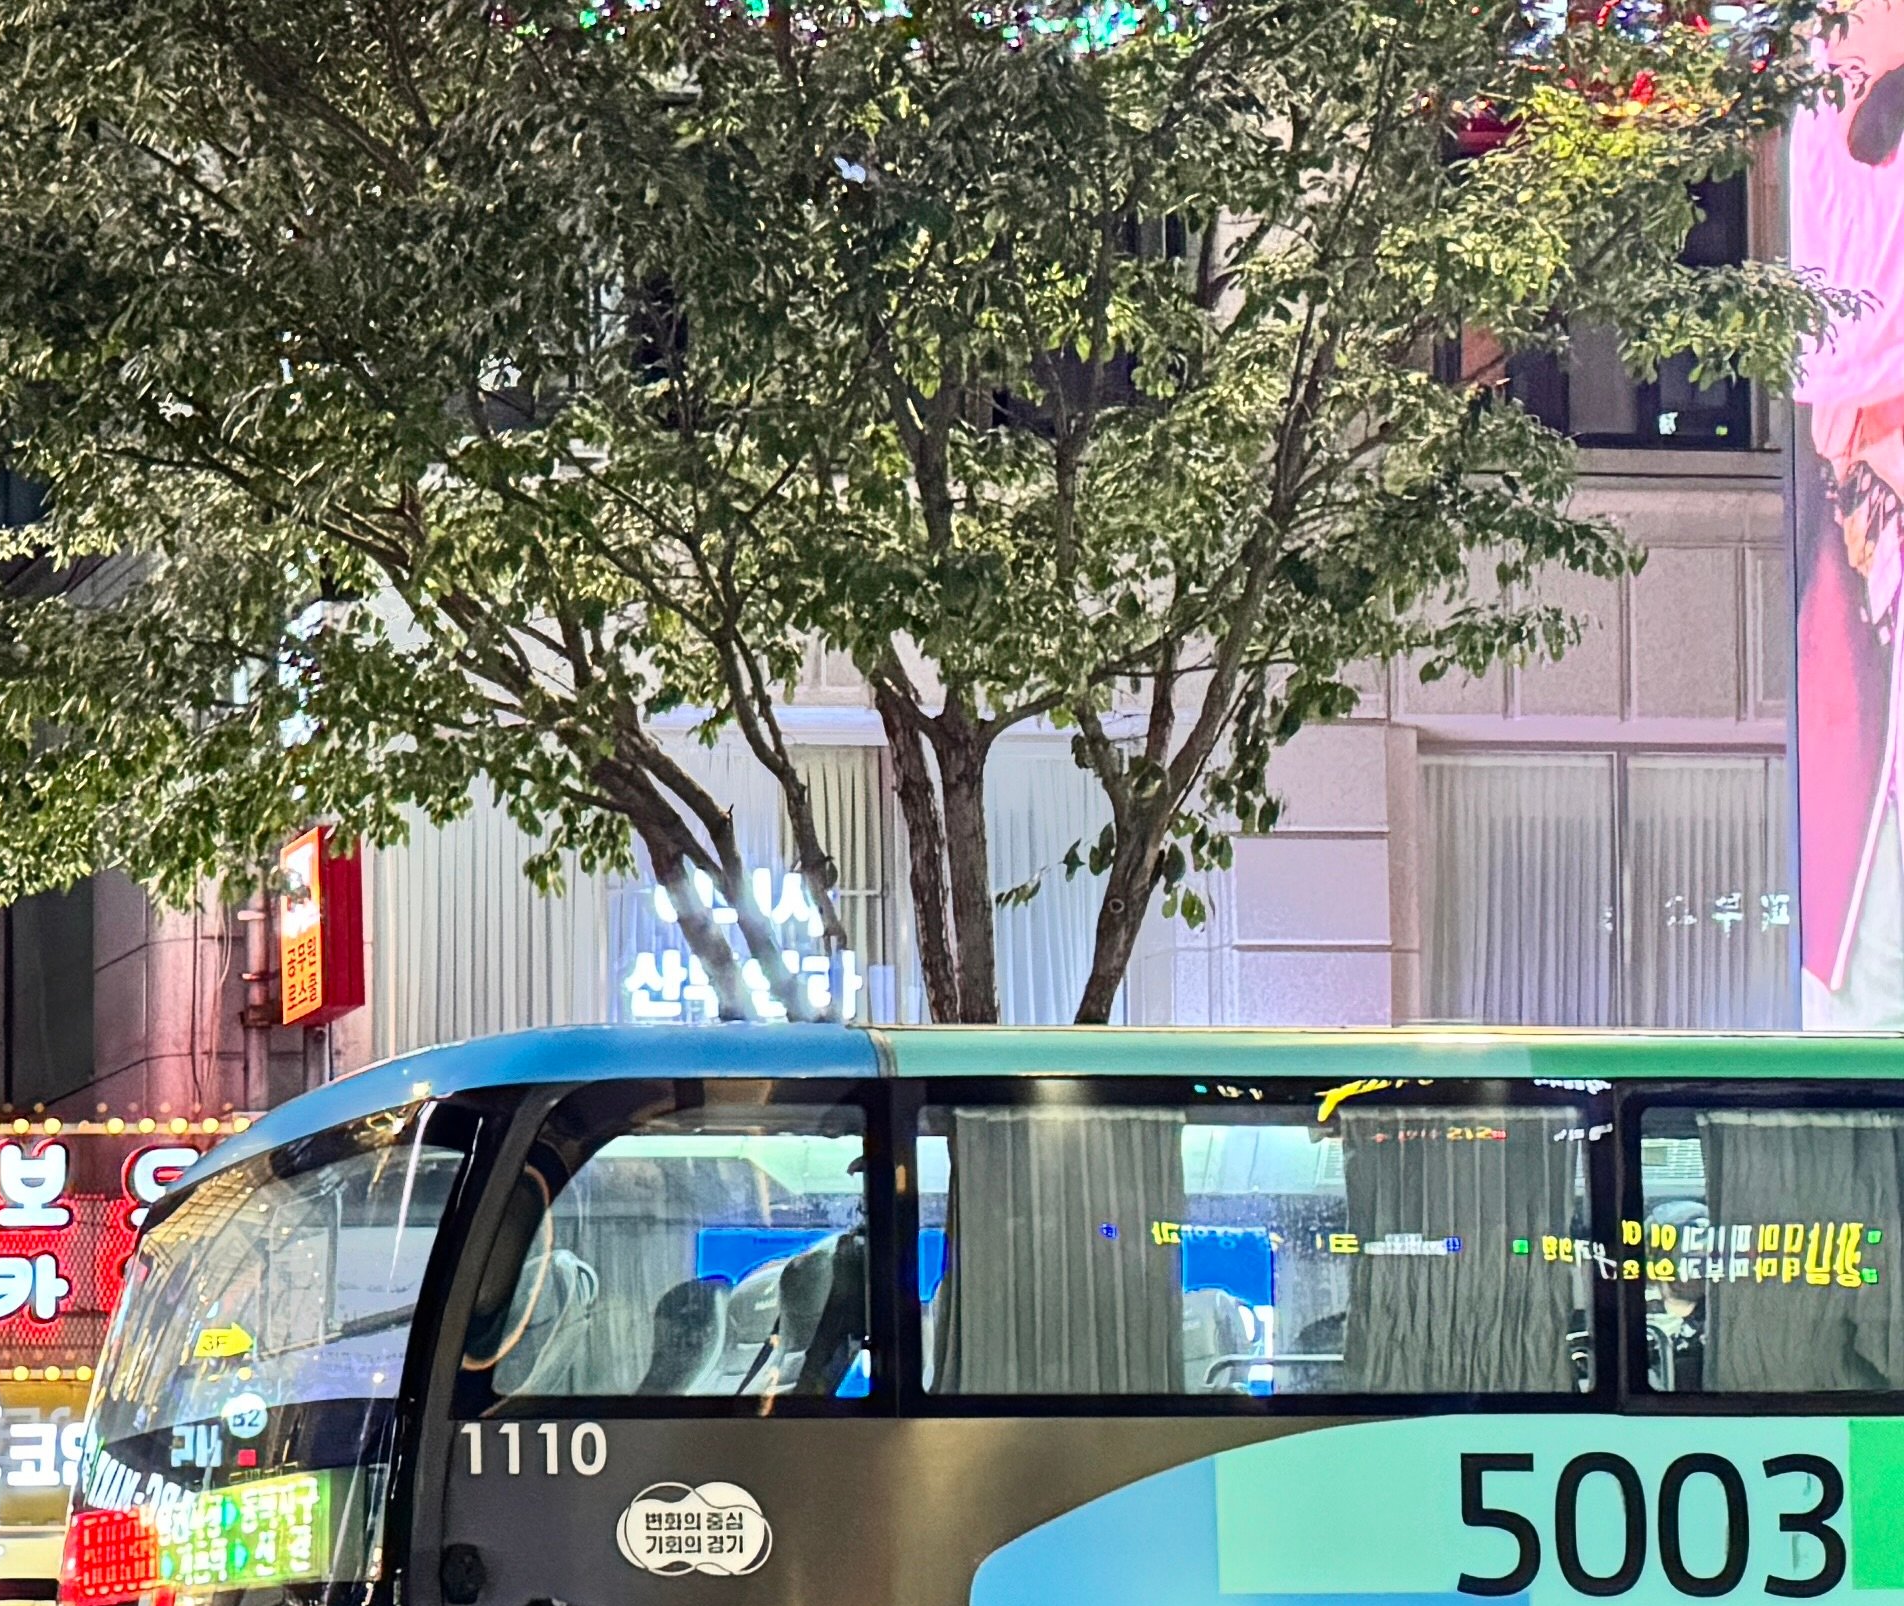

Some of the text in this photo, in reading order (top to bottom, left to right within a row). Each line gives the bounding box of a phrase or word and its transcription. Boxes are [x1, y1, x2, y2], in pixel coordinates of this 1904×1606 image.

[202, 1333, 230, 1352] 3F
[461, 1422, 609, 1478] 1110
[645, 1512, 744, 1532] 변화의 중심
[1456, 1452, 1847, 1599] 5003
[645, 1535, 744, 1555] 기회의 경기
